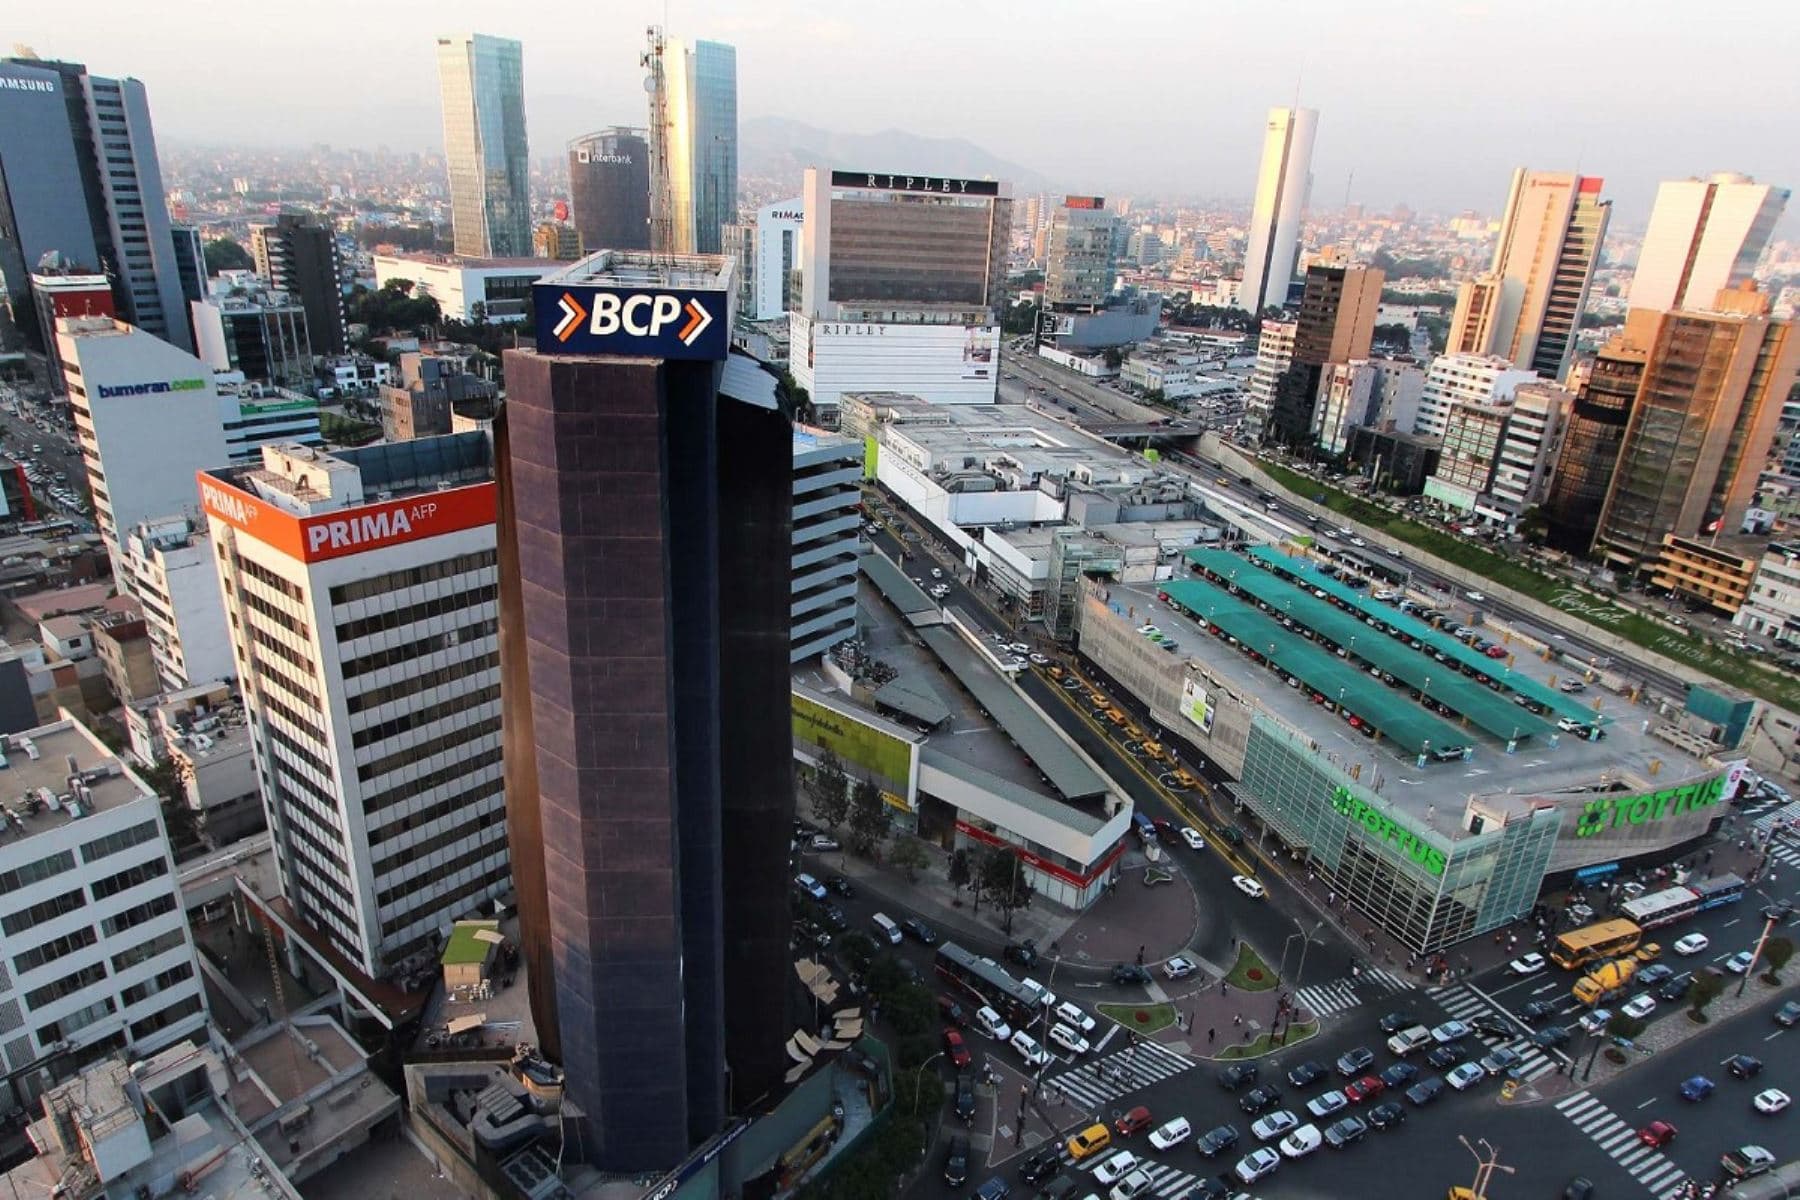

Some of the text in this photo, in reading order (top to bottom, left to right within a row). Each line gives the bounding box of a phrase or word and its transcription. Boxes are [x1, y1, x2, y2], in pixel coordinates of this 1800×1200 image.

[867, 174, 968, 193] RIPLEY
[590, 293, 681, 336] BCP
[822, 324, 888, 335] RIPLEY
[201, 482, 248, 525] PRIMA
[307, 503, 437, 552] PRIMA AFP
[1611, 773, 1727, 829] TOTTUS
[1351, 799, 1446, 877] TOTTUS
